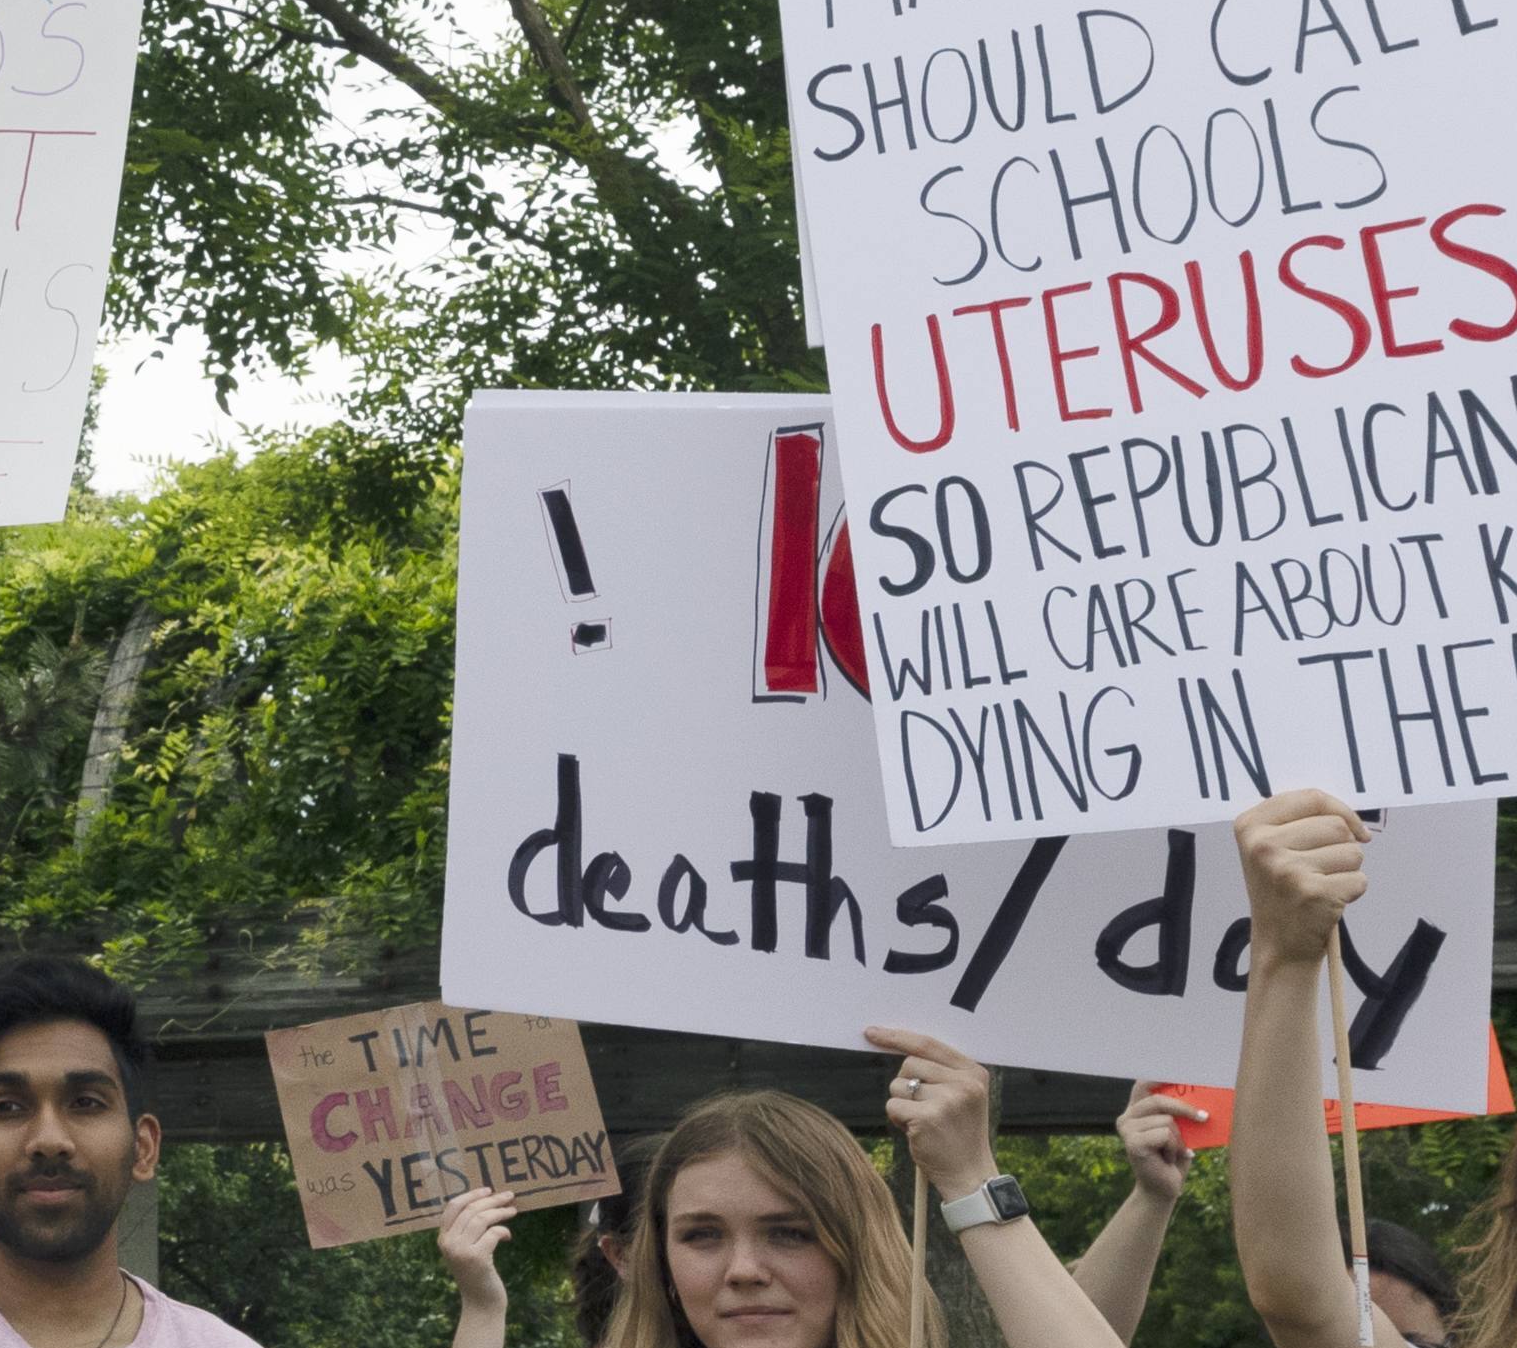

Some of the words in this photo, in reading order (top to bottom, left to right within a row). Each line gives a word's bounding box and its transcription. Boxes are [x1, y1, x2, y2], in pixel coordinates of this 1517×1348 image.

[806, 7, 1155, 162] SHOULD
[918, 85, 1389, 287] SCHOOLS
[868, 475, 994, 598] SO
[872, 604, 1028, 702] WILL
[1041, 566, 1205, 670] CARE
[1232, 533, 1449, 656] ABOUT
[899, 685, 1143, 832] DYING
[1178, 665, 1273, 802] IN
[298, 1044, 336, 1068] the
[348, 1010, 499, 1073] TIME
[309, 1061, 569, 1153] CHANGE
[306, 1172, 357, 1196] was
[361, 1129, 609, 1219] YESTERDAY
